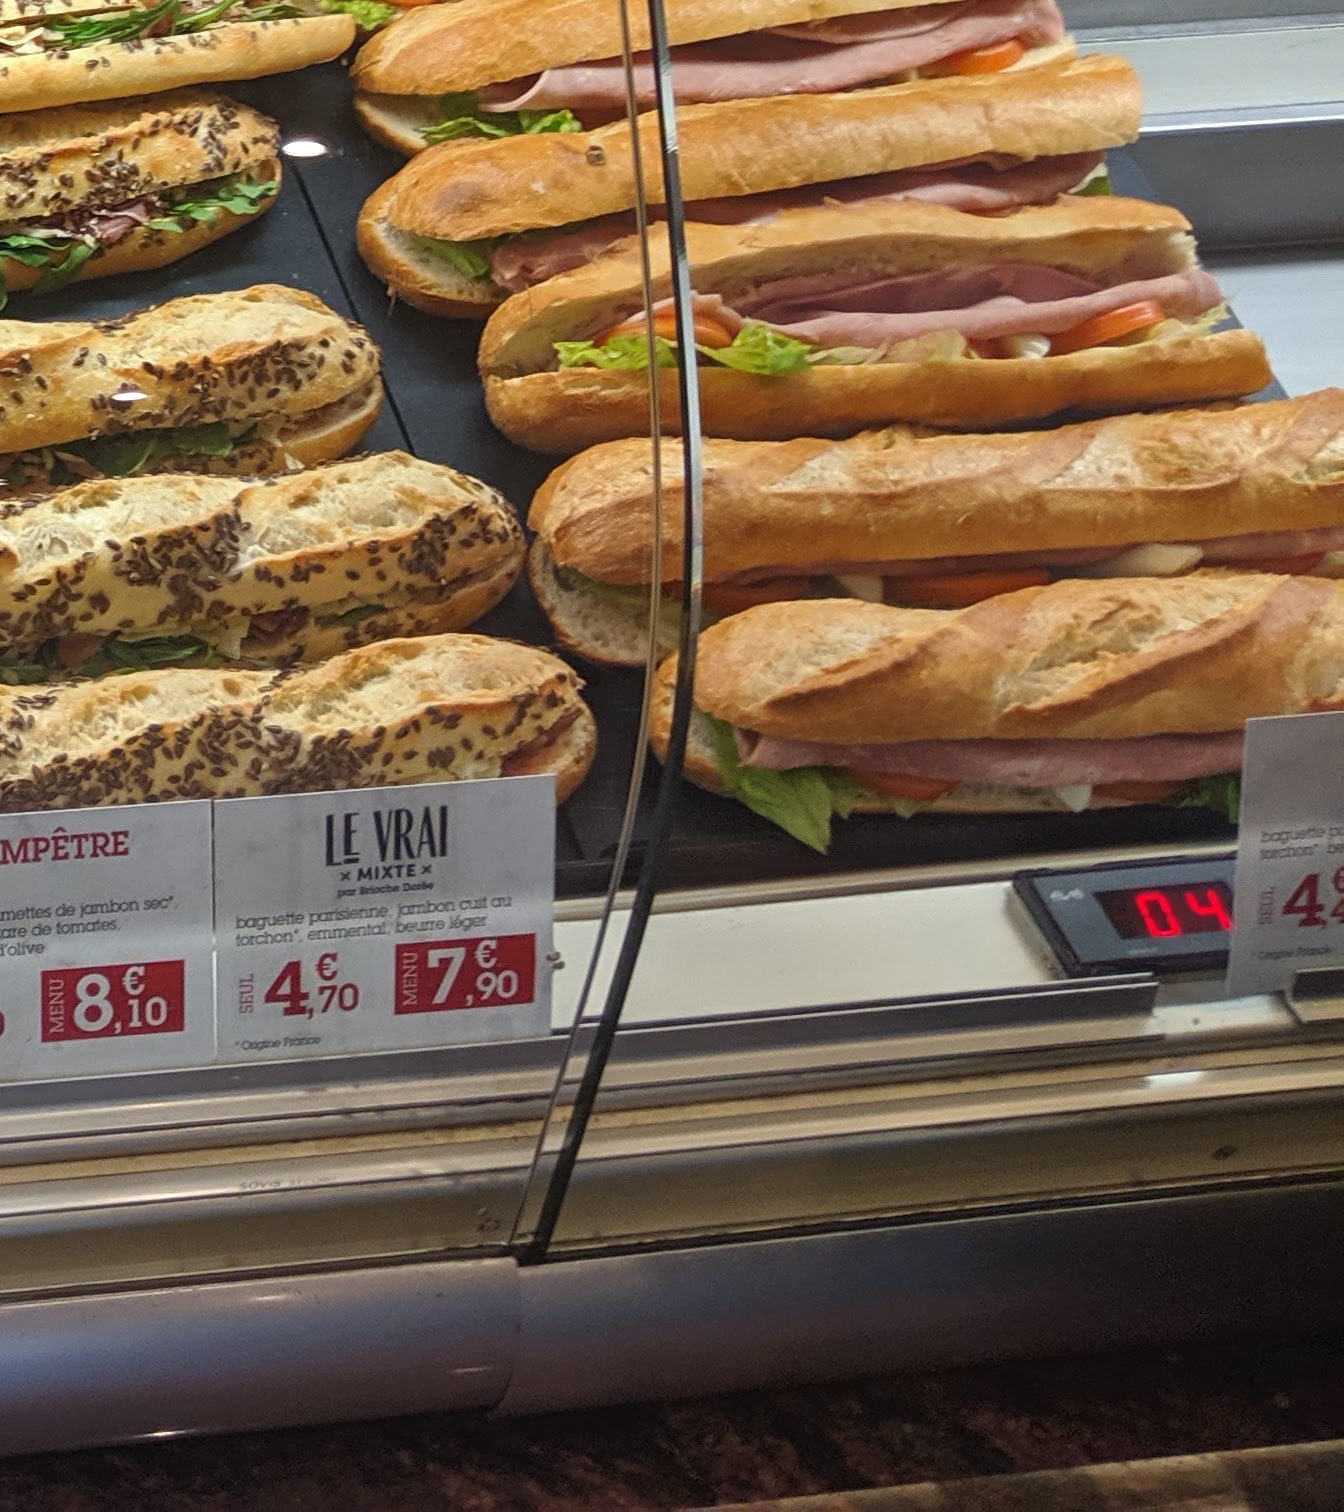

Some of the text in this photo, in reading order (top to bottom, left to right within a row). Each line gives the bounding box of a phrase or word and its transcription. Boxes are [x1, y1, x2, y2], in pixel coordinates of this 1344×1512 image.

[325, 805, 448, 866] LE VRAI
[357, 863, 416, 882] MIXTE
[55, 902, 76, 917] de
[79, 899, 140, 918] jambon
[236, 913, 305, 931] baguette
[397, 901, 456, 919] jambon
[459, 896, 487, 912] cuit
[491, 895, 512, 908] au
[395, 918, 446, 933] beurre
[449, 915, 487, 931] léger
[31, 922, 53, 937] de
[239, 973, 254, 1015] SEUL
[401, 952, 418, 1007] MENU
[49, 978, 65, 1034] MENU
